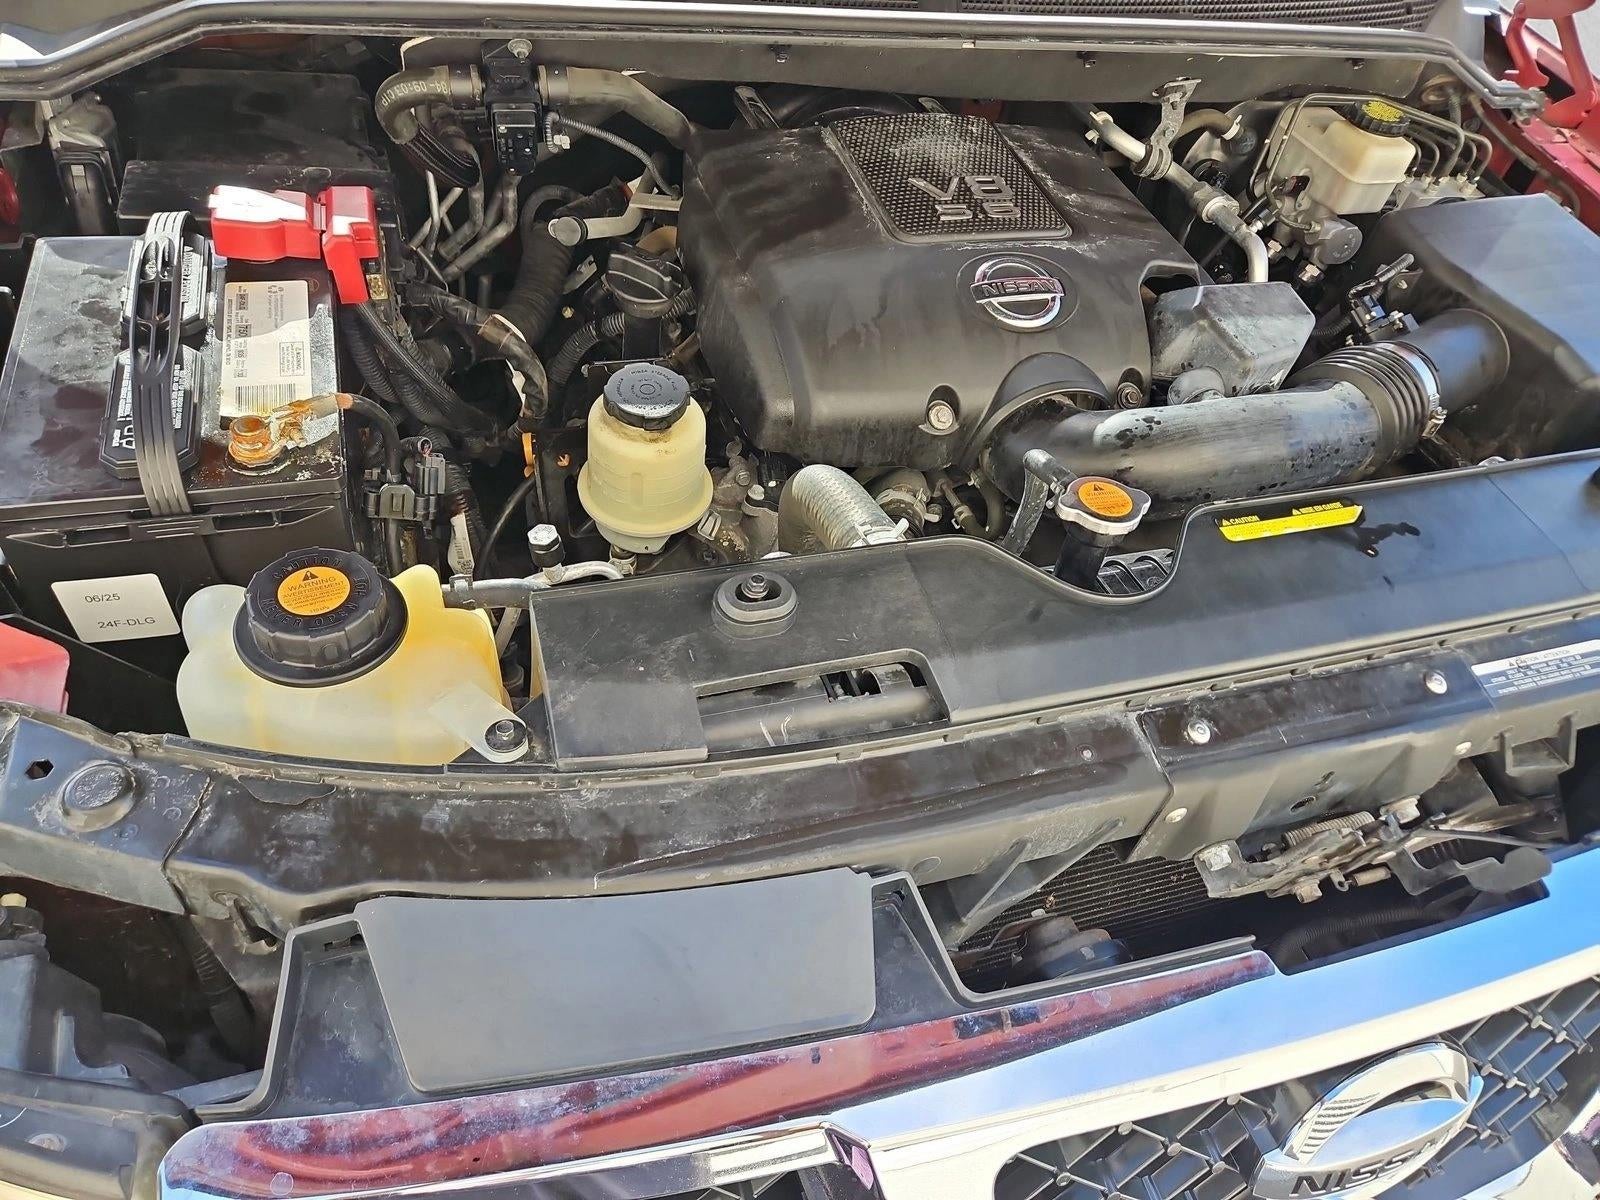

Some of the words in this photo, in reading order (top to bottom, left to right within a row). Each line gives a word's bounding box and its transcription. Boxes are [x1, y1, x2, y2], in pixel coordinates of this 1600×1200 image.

[908, 175, 1015, 201] V8
[935, 202, 1021, 221] 5.6
[982, 279, 1055, 298] NISSAN
[1229, 515, 1260, 525] CAUTION
[288, 577, 336, 592] WARNING
[84, 593, 121, 603] 06/25
[97, 616, 156, 629] 24F-DLG
